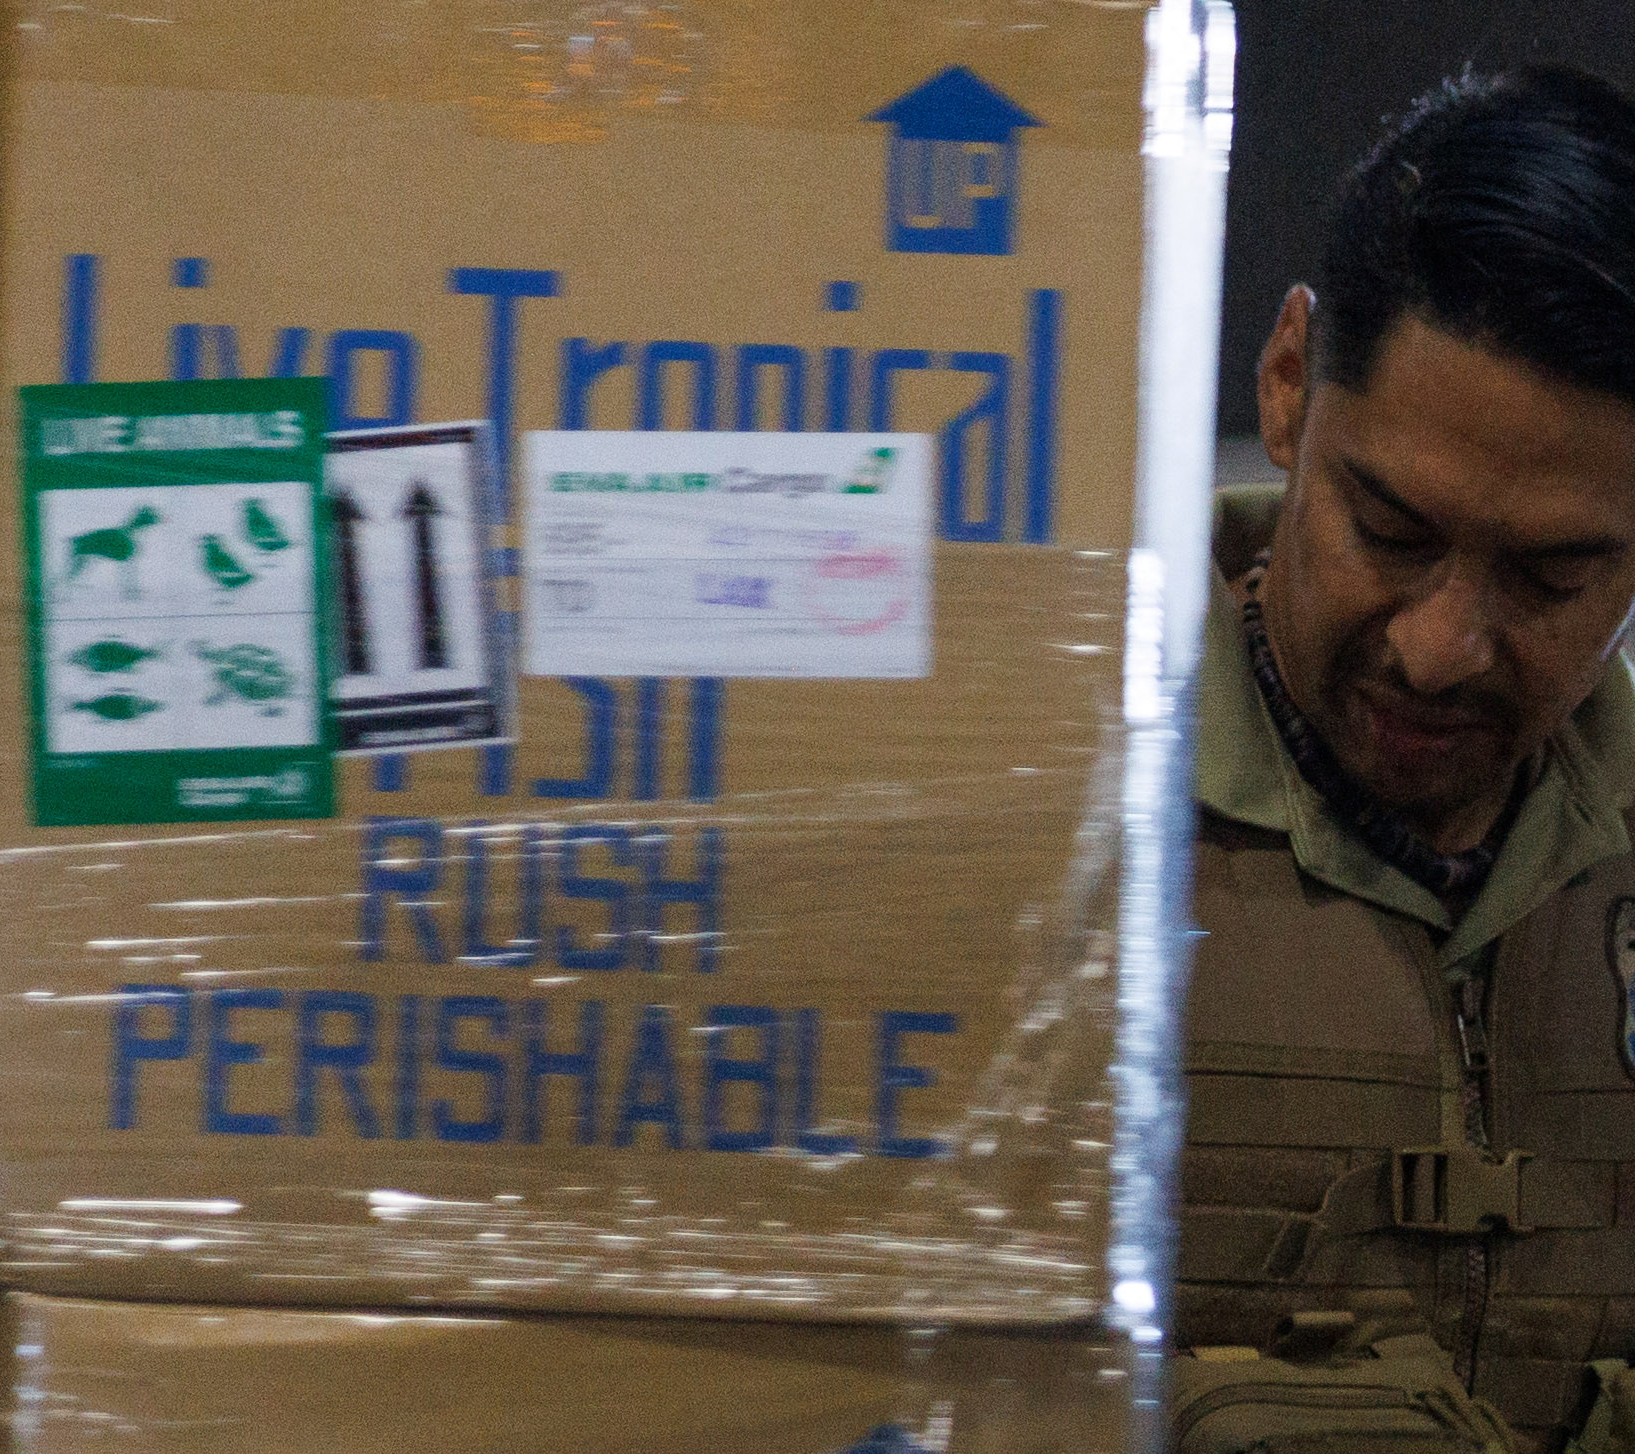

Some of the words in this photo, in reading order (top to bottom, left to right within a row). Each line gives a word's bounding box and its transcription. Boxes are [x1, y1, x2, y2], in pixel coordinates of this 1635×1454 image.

[896, 142, 1000, 228] UP
[364, 817, 724, 973] RUSH
[110, 982, 958, 1160] PERISHABLE
